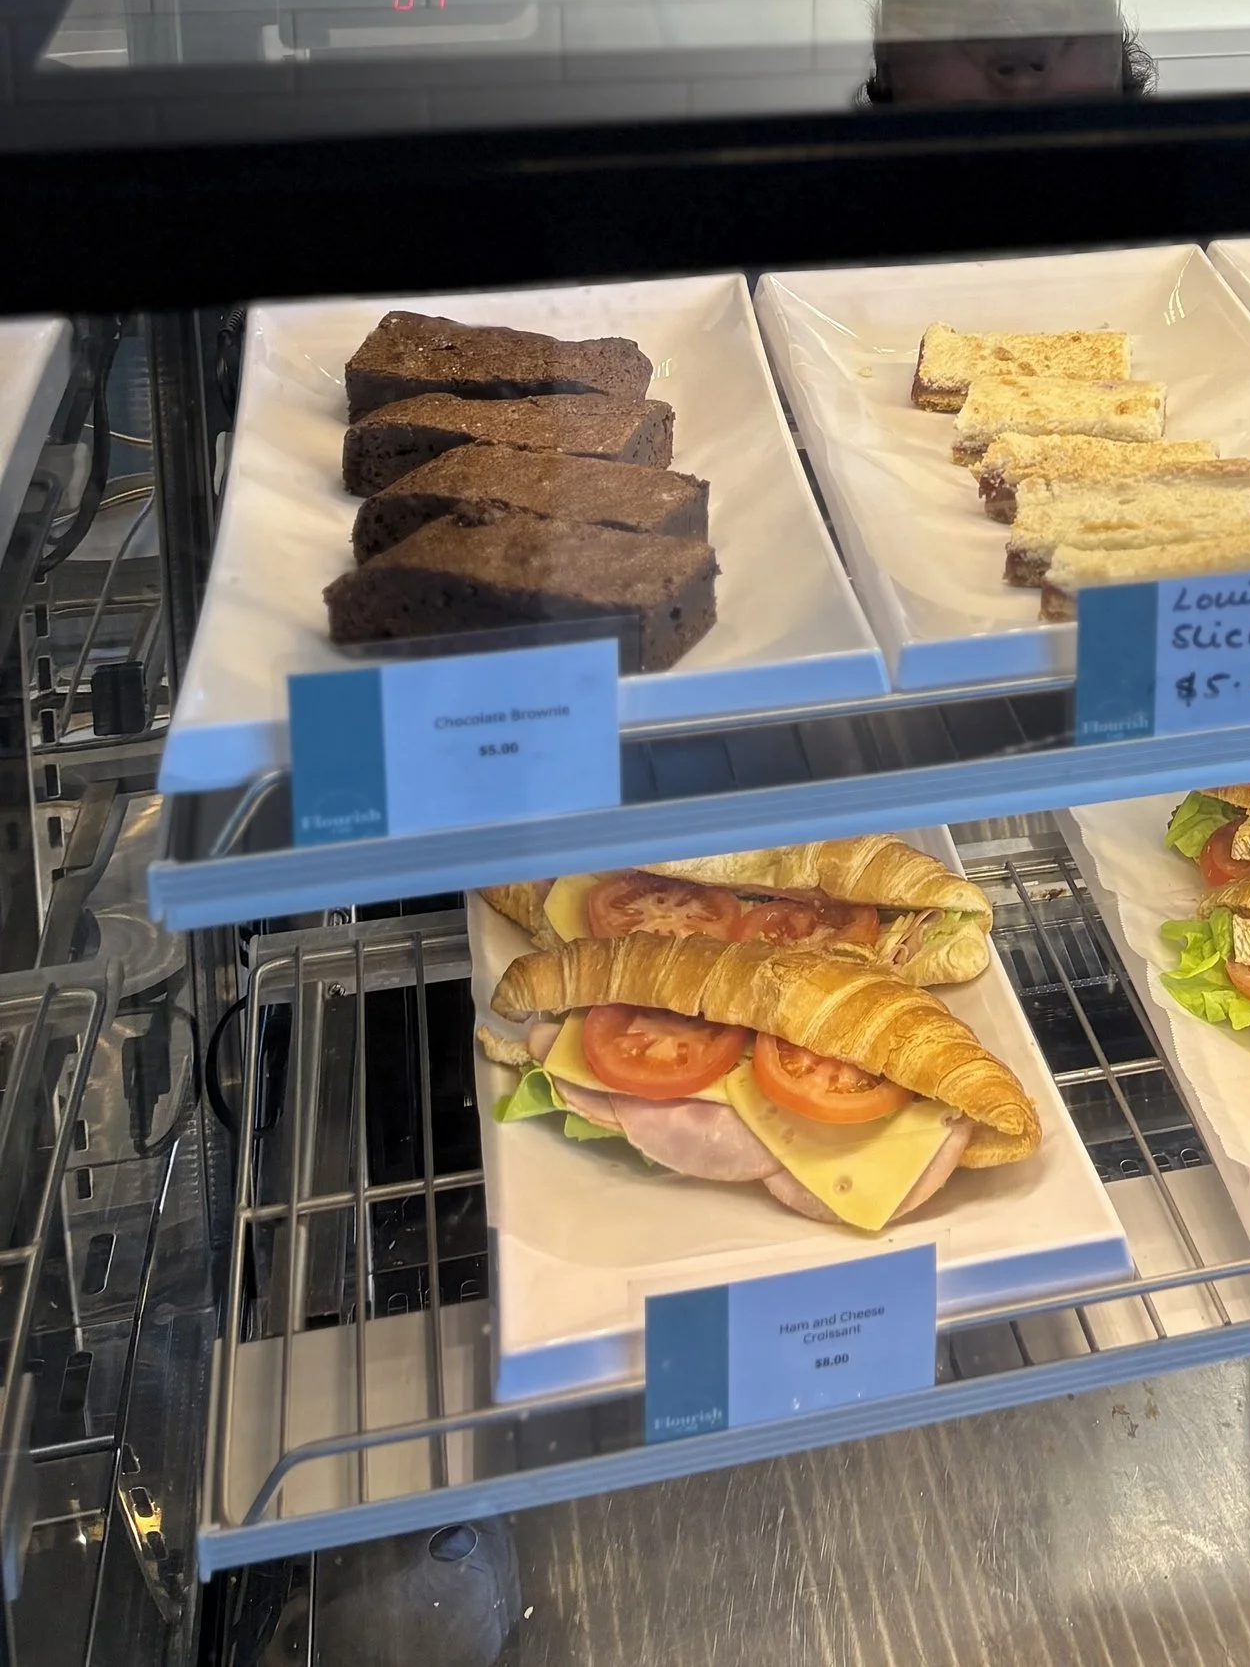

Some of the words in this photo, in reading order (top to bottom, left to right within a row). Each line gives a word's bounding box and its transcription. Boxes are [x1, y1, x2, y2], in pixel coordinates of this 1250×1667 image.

[433, 712, 507, 729] Chocolate
[511, 705, 570, 721] Brownie
[478, 742, 519, 756] $5.00
[779, 1320, 810, 1335] Ham
[812, 1313, 837, 1329] and
[840, 1305, 885, 1323] Cheese
[803, 1323, 862, 1344] Croissant
[815, 1353, 850, 1369] $8.00
